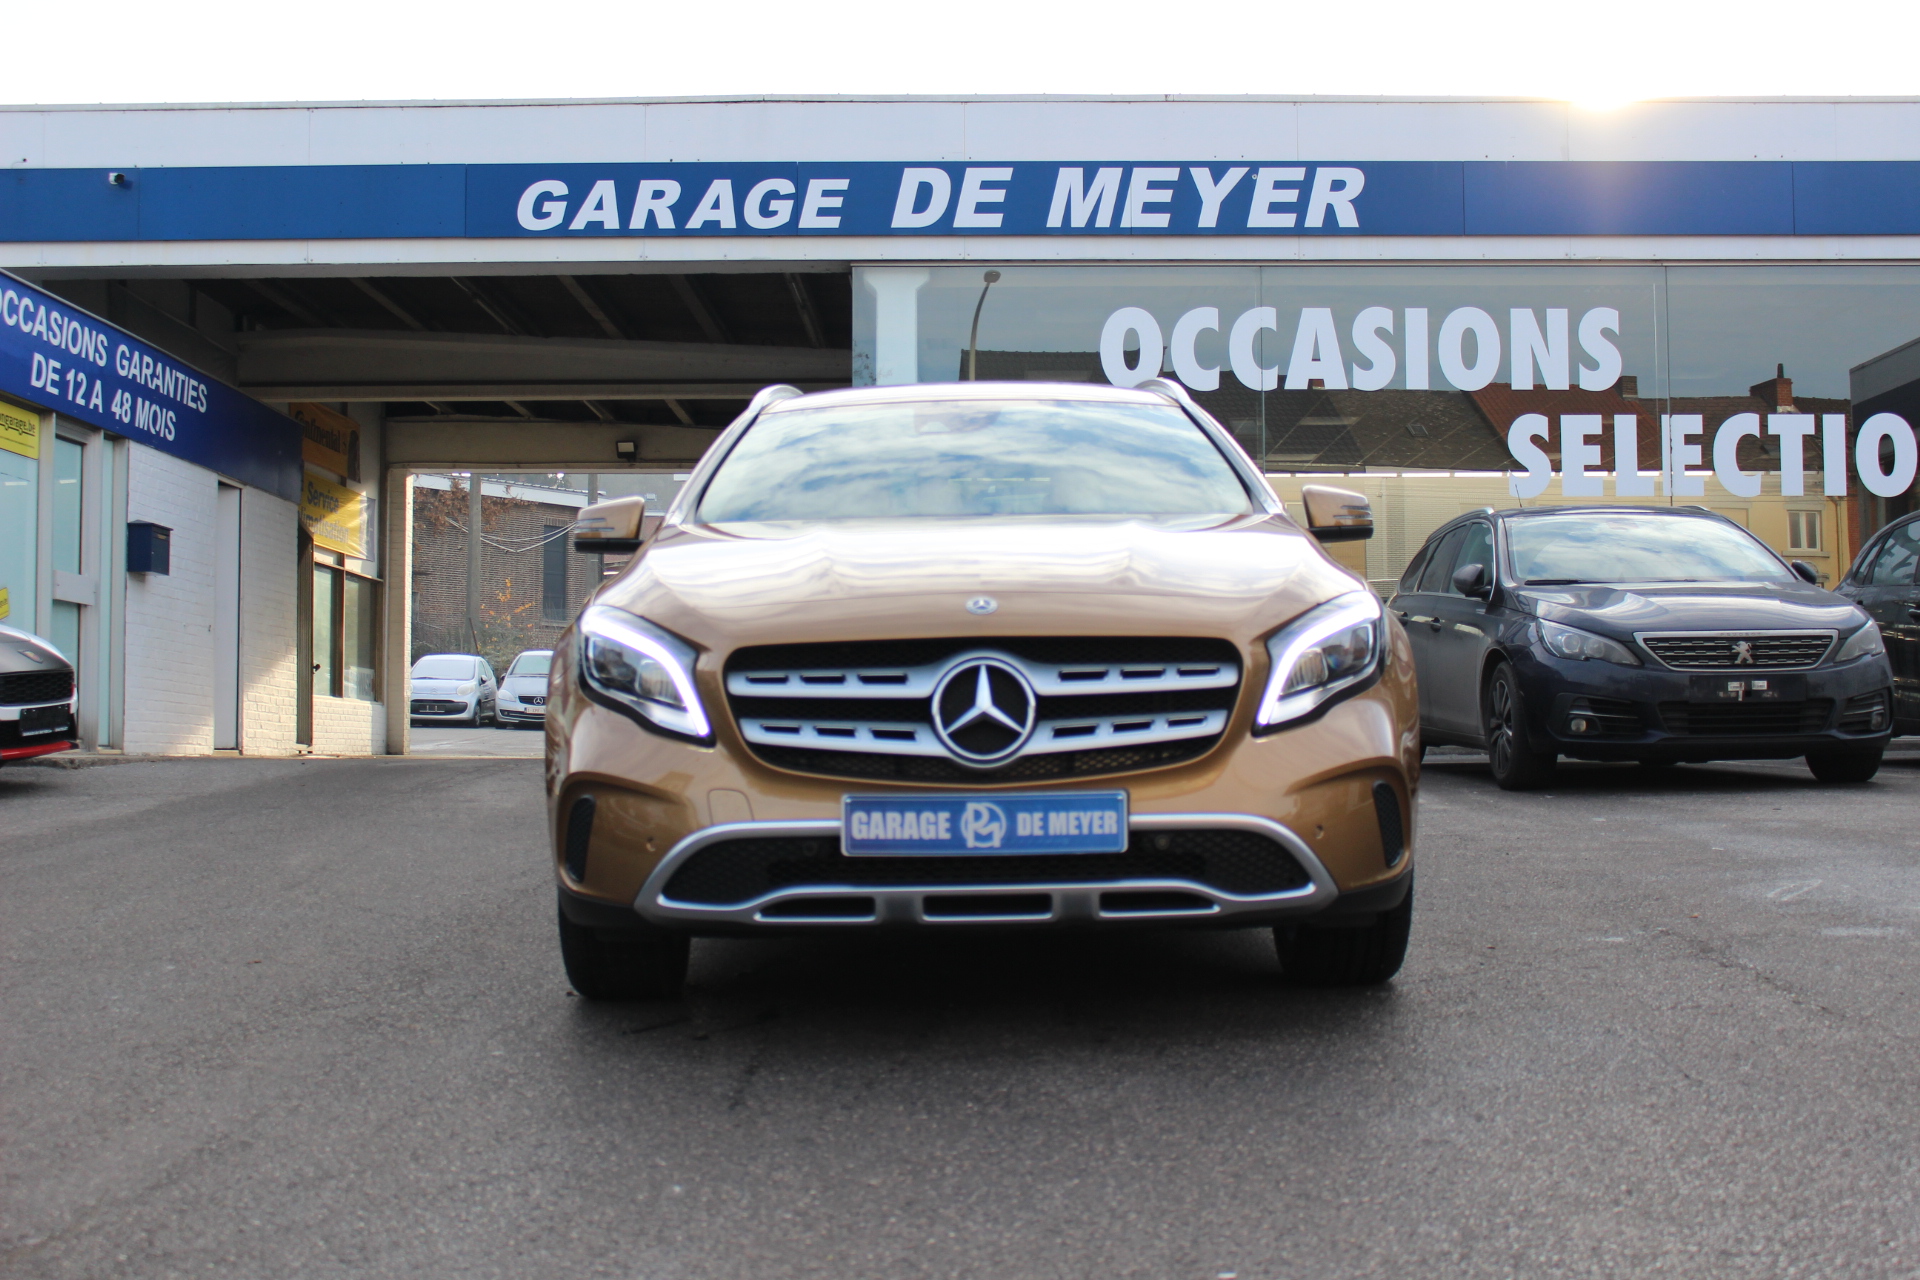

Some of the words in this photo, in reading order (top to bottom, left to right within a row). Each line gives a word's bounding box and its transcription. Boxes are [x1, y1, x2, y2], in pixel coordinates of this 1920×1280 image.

[516, 178, 850, 231] GARAGE
[890, 166, 1014, 229] DE
[1046, 166, 1366, 229] MEYER
[0, 287, 108, 367] CCASIONS
[115, 344, 208, 413] GARANTIES
[1100, 305, 1623, 392] OCCASIONS
[30, 352, 62, 396] DE
[65, 368, 87, 407] 12
[89, 379, 104, 413] A
[110, 388, 132, 424] 48
[134, 396, 177, 441] MOIS
[1506, 412, 1918, 498] SELECTIO
[298, 505, 350, 544] limatisation
[307, 480, 340, 514] Service
[850, 811, 952, 841] GARAGE
[1016, 811, 1045, 837] DE
[1048, 809, 1118, 837] MEYER
